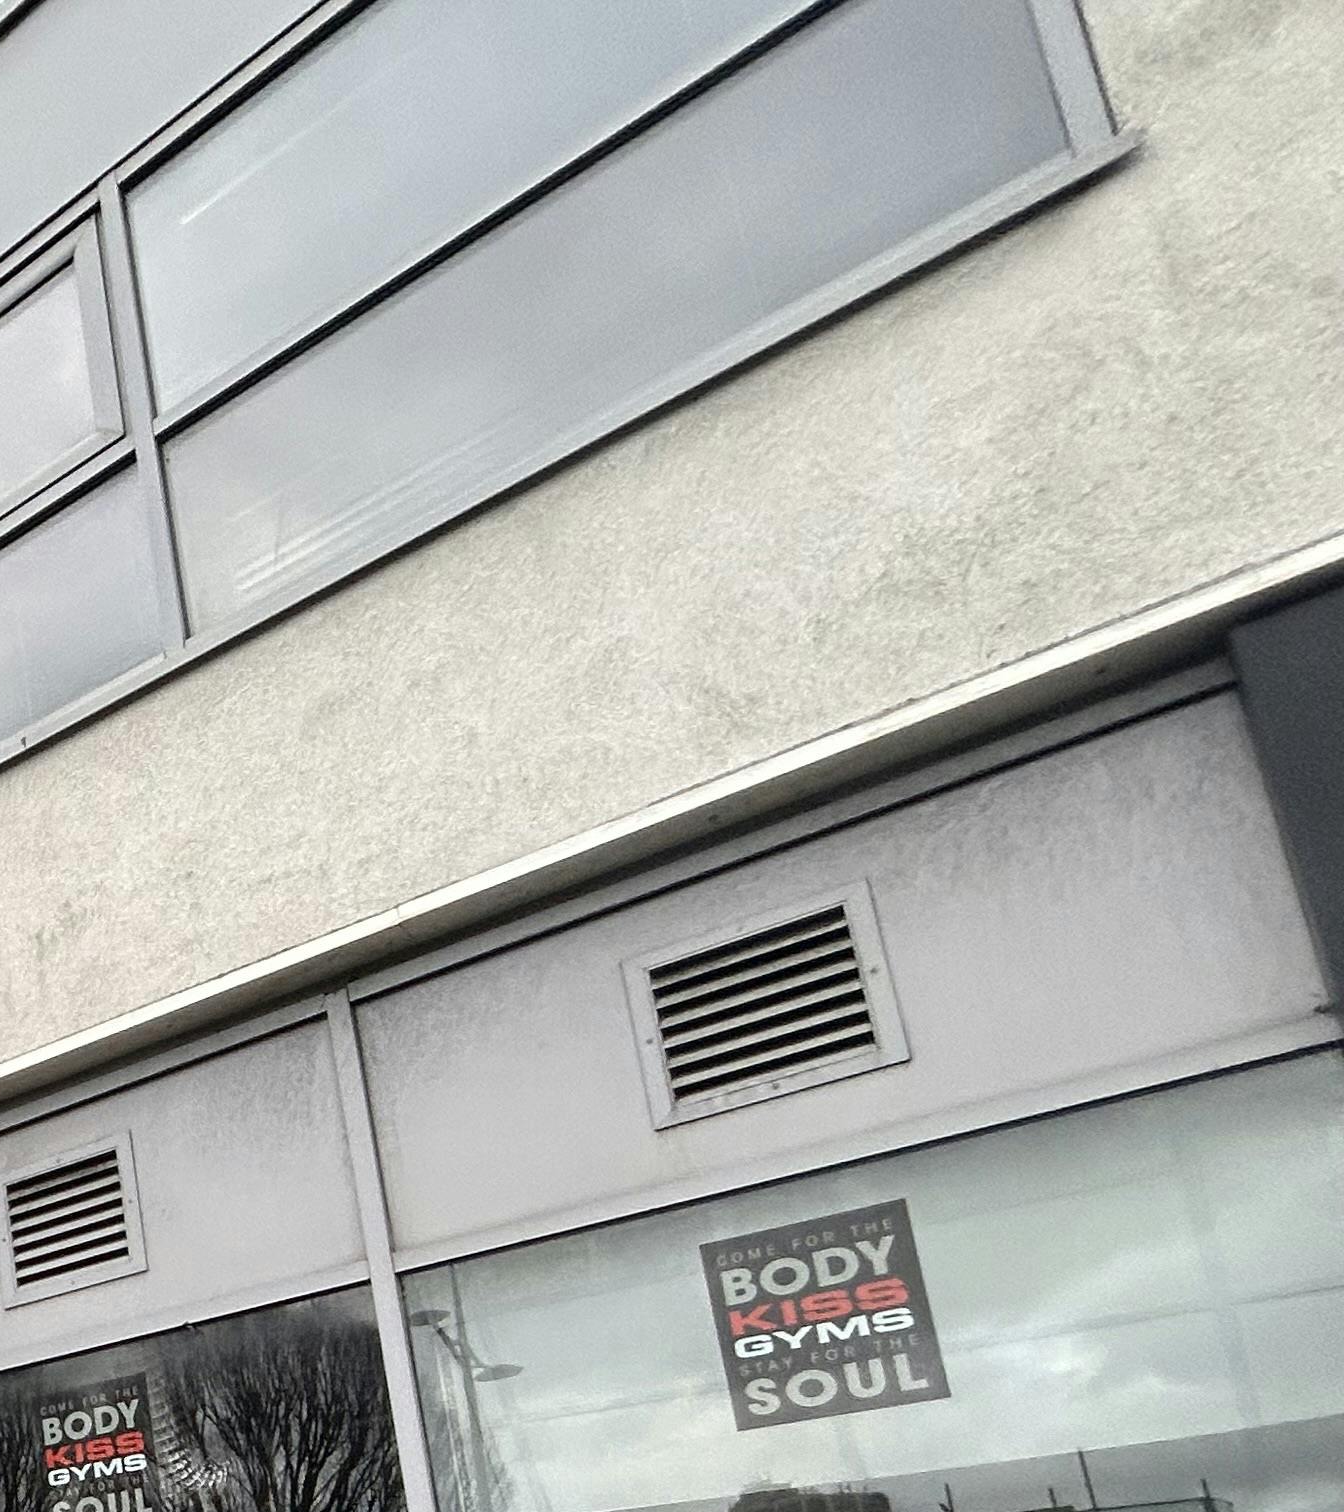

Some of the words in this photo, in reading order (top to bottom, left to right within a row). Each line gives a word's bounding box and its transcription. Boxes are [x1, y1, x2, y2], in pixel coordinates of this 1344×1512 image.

[716, 1244, 776, 1267] COME
[791, 1231, 835, 1250] FOR
[850, 1218, 894, 1237] THE
[719, 1234, 896, 1307] BODY
[728, 1277, 910, 1337] KISS
[734, 1307, 915, 1359] GYMS
[739, 1355, 793, 1377] STAY
[810, 1344, 855, 1364] FOR
[873, 1334, 920, 1354] THE
[82, 1392, 107, 1408] FOR
[114, 1385, 139, 1400] THE
[744, 1353, 929, 1416] SOUL
[41, 1399, 140, 1446] BODY
[44, 1431, 145, 1468] KISS
[47, 1453, 148, 1487] GYMS
